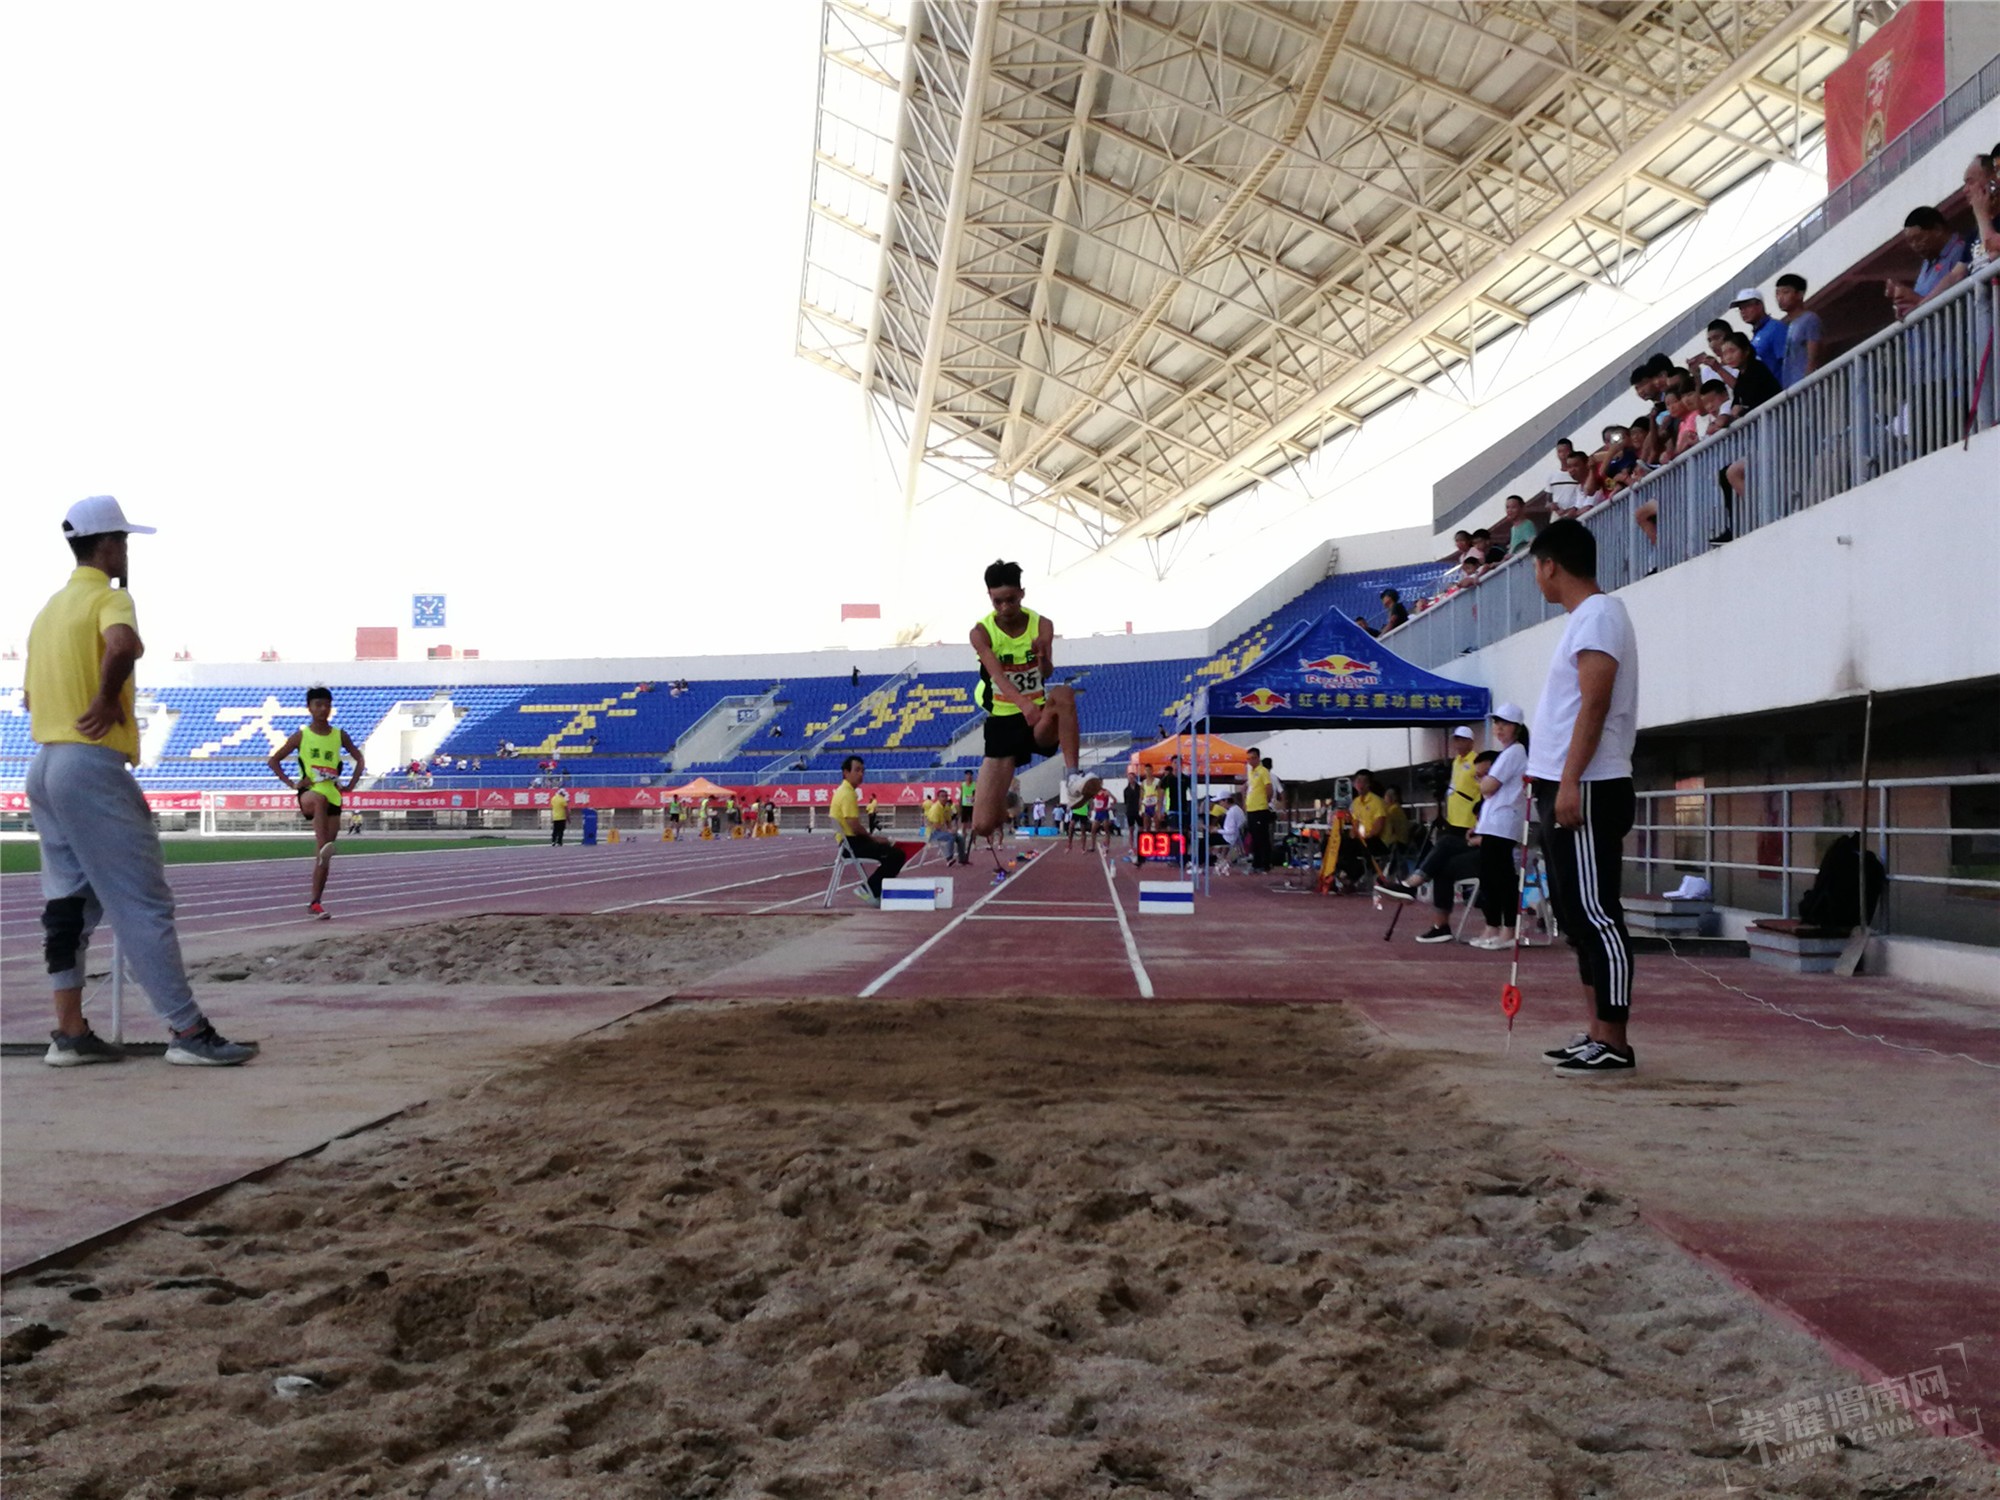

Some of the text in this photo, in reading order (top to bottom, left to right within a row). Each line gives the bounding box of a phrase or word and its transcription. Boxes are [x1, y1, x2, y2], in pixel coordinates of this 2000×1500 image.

[1298, 692, 1463, 709] 红牛维生素功能饮料
